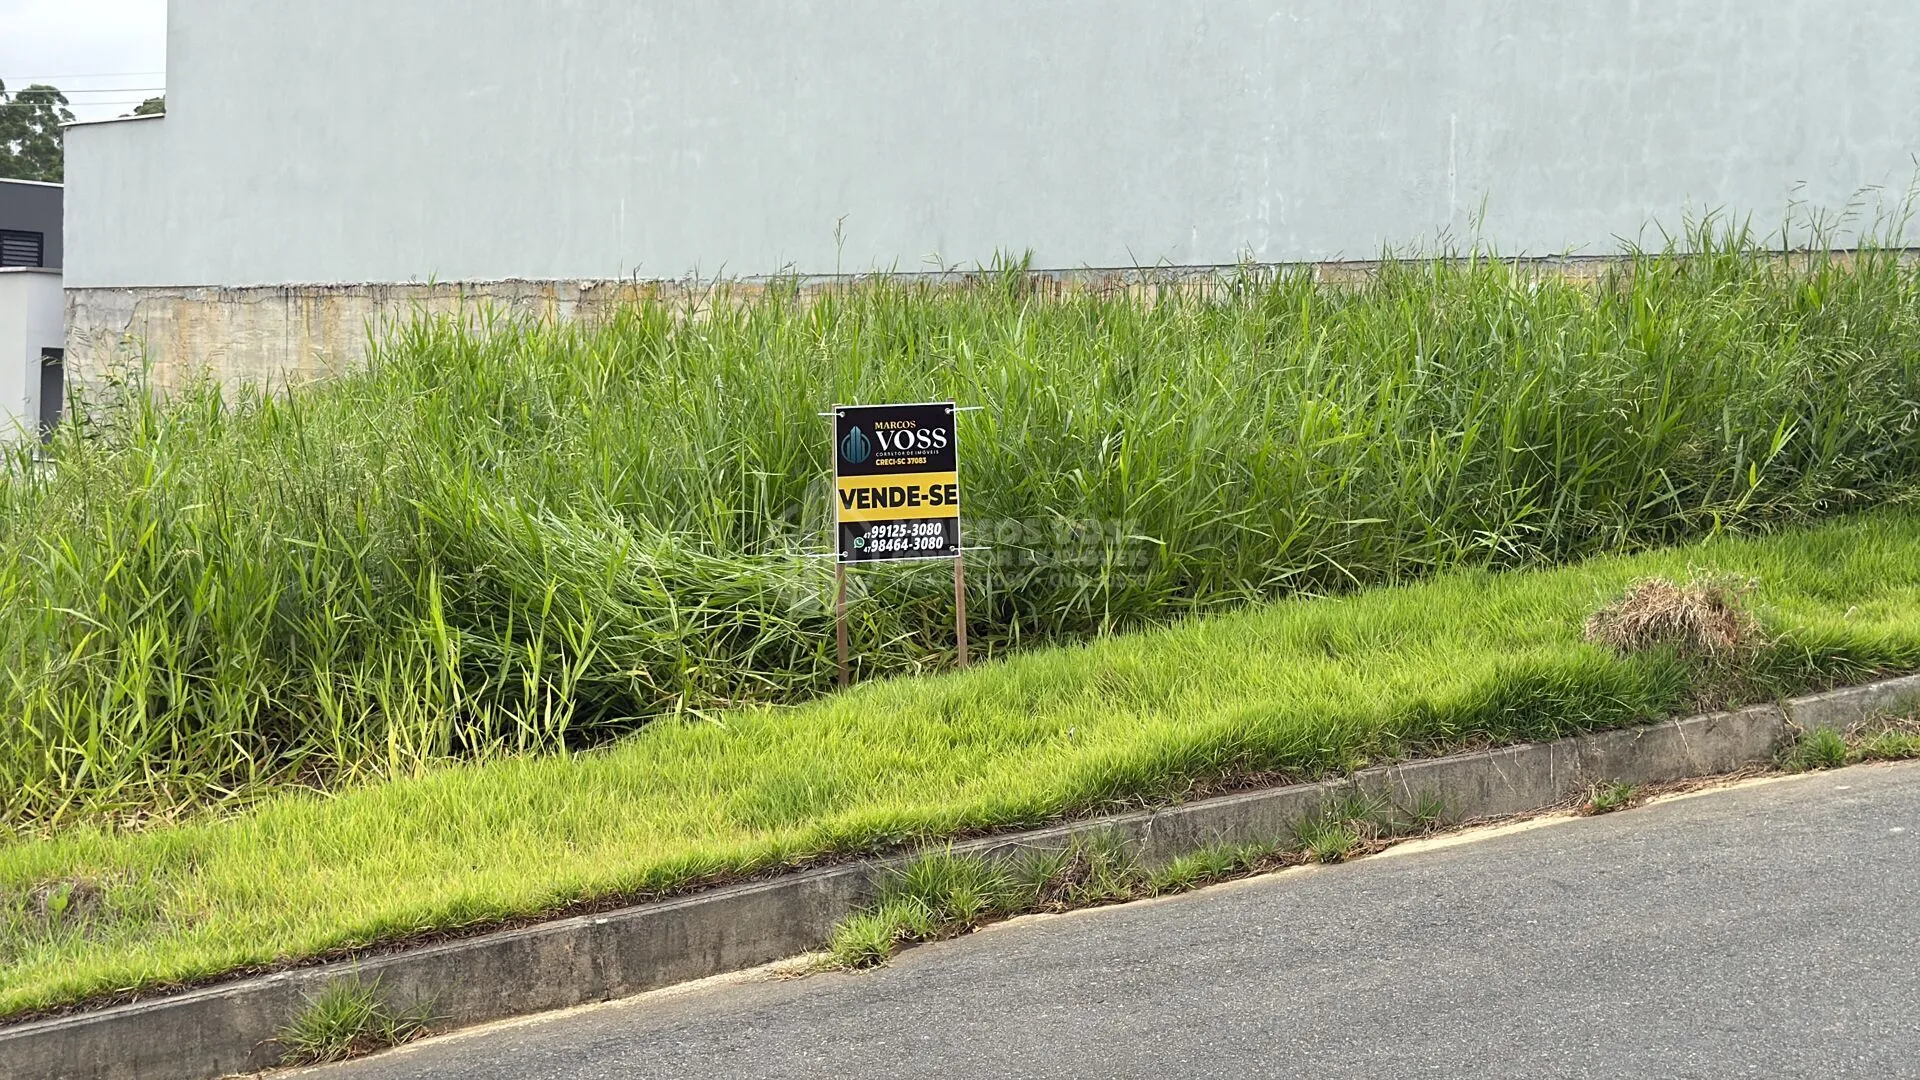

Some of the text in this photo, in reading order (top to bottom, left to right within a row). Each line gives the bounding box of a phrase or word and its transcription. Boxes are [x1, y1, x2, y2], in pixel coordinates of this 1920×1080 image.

[874, 420, 917, 430] MARCOS
[875, 427, 948, 451] VOSS
[875, 456, 927, 466] CRECI-SC 37083
[838, 484, 958, 510] VENDE-SE
[870, 522, 942, 539] 99125-3080
[870, 536, 944, 553] 98464-3080
